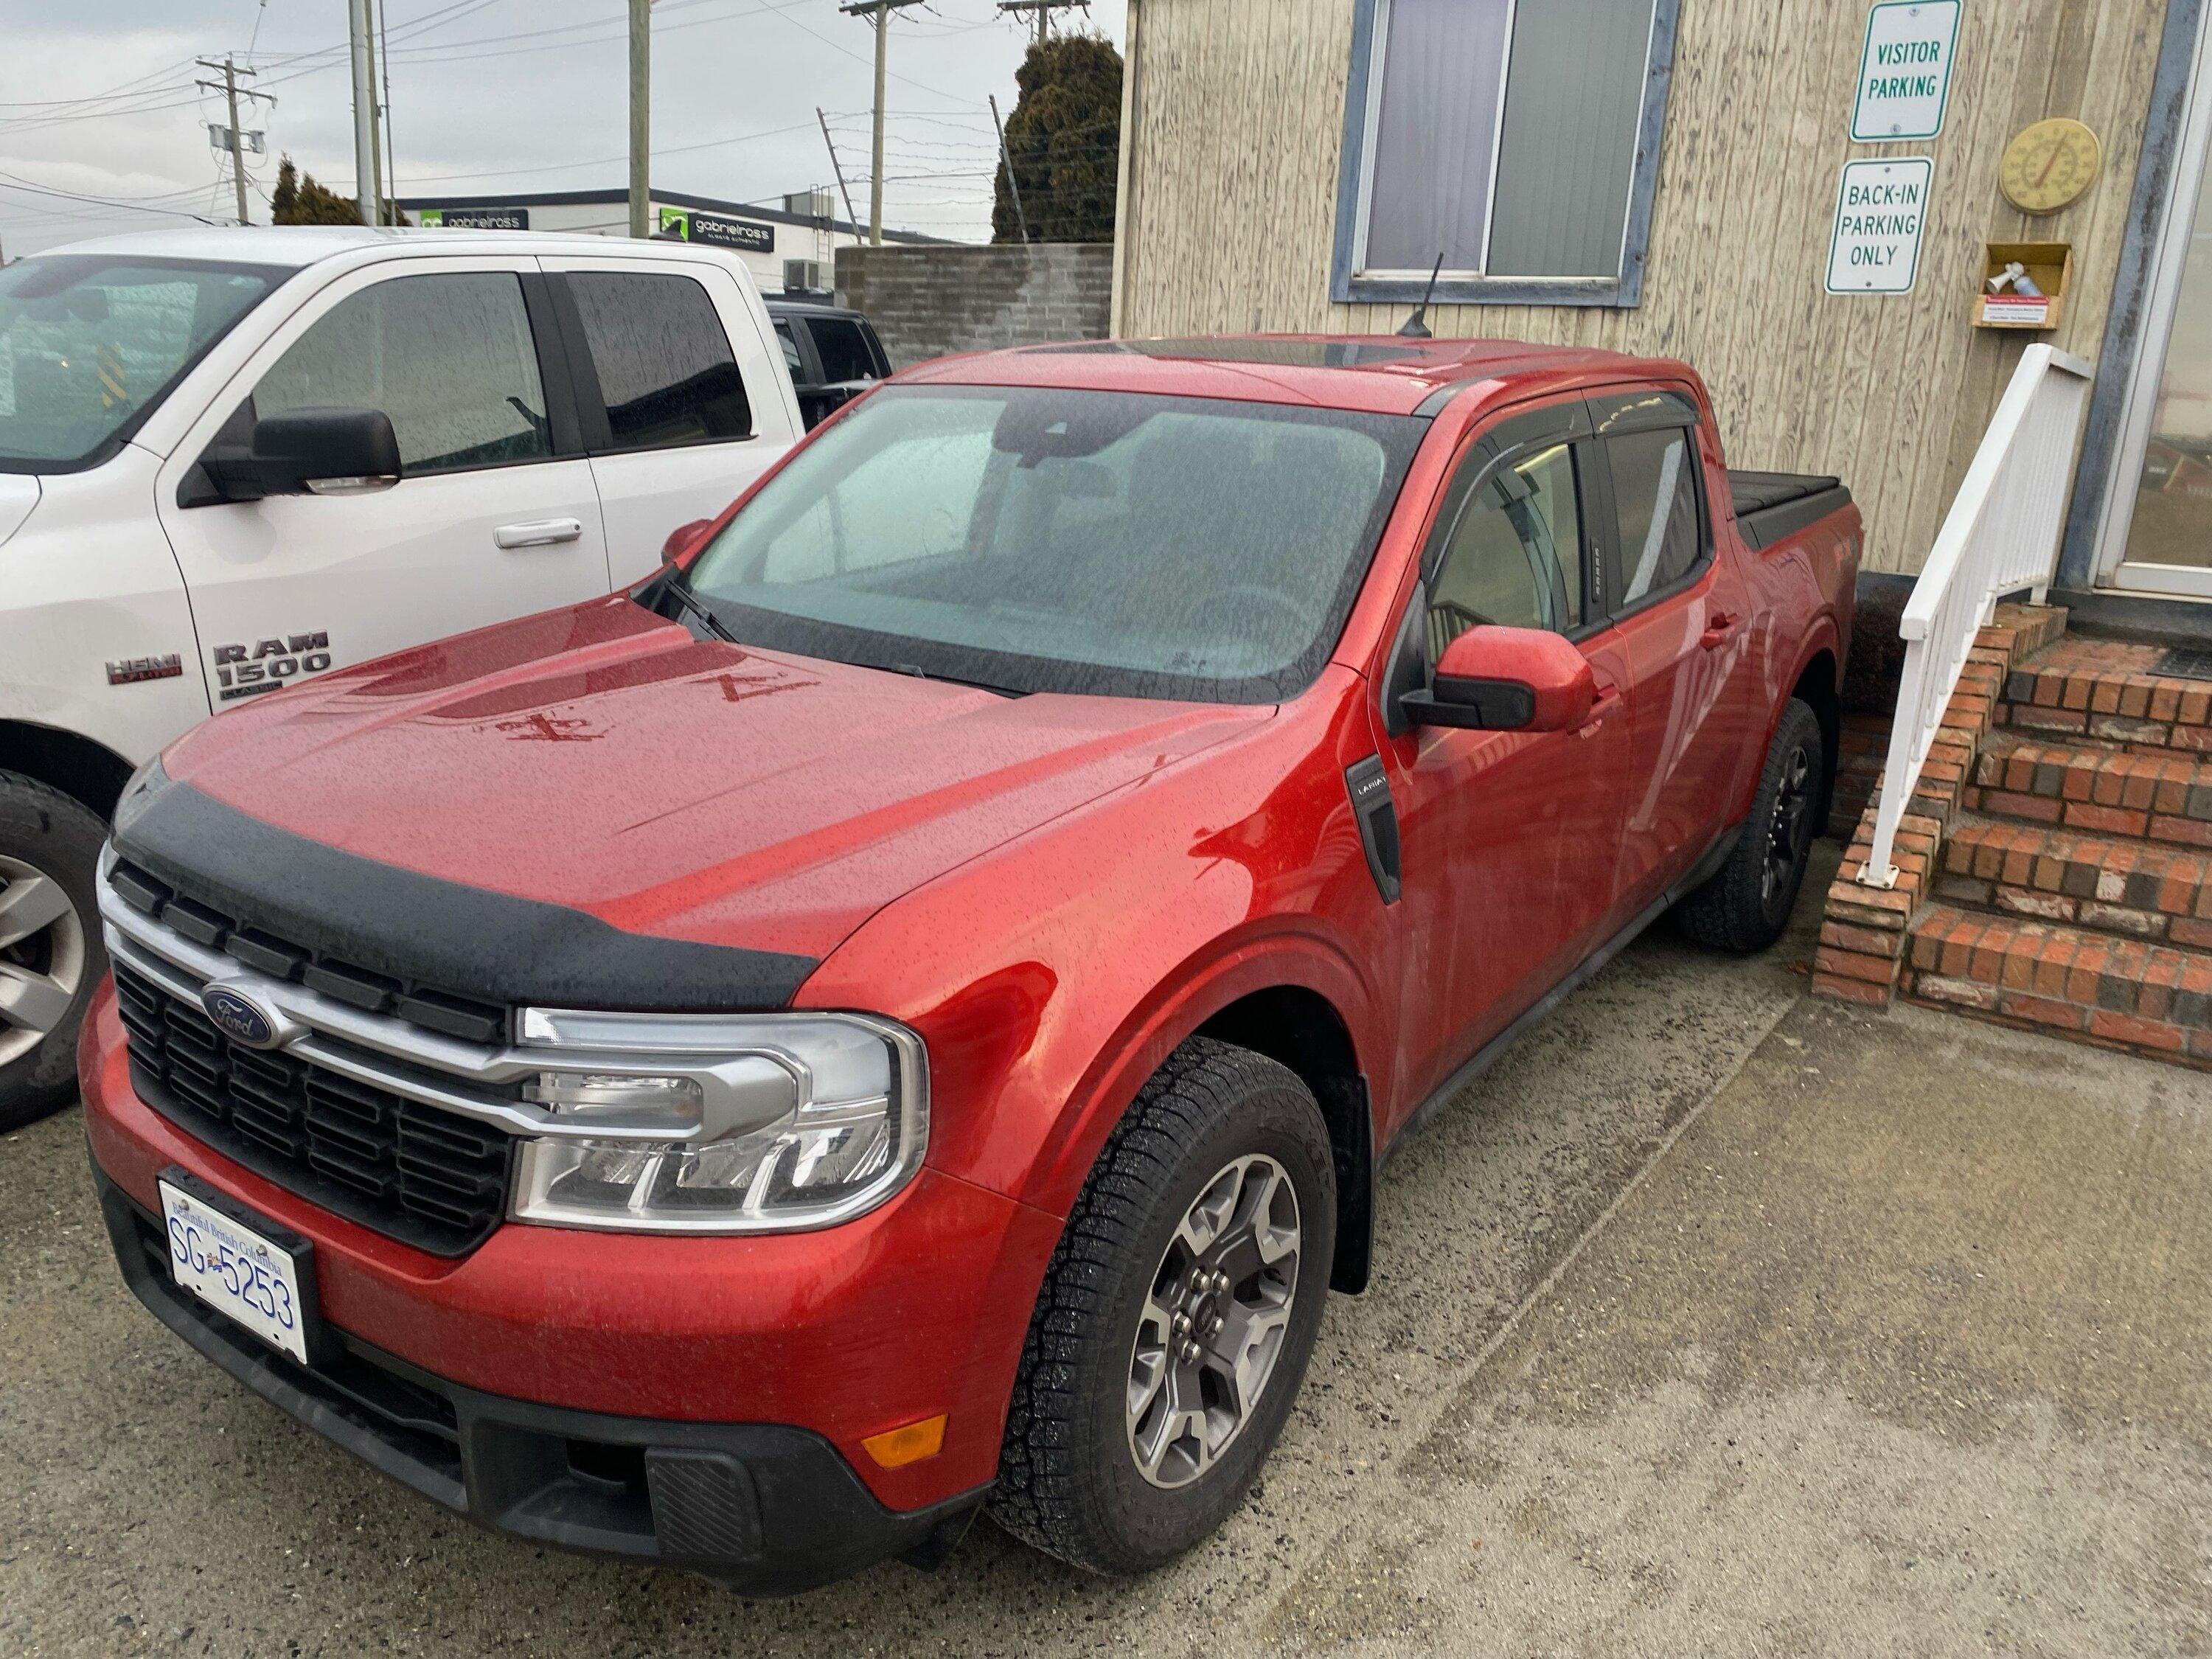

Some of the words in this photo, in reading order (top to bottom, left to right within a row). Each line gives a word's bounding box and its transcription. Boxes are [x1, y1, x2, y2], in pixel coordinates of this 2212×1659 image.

[1878, 41, 1941, 65] VISITOR
[1868, 75, 1937, 100] PARKING
[1848, 184, 1919, 206] BACK-IN
[695, 220, 770, 240] gabrielross
[1841, 216, 1916, 235] PARKING
[1851, 246, 1897, 265] ONLY
[213, 630, 329, 665] RAM
[105, 653, 182, 675] HEMI
[218, 653, 330, 686] 1500
[215, 998, 254, 1037] Ford
[210, 1223, 238, 1251] British
[170, 1217, 204, 1273] SG
[219, 1244, 293, 1329] 5253
